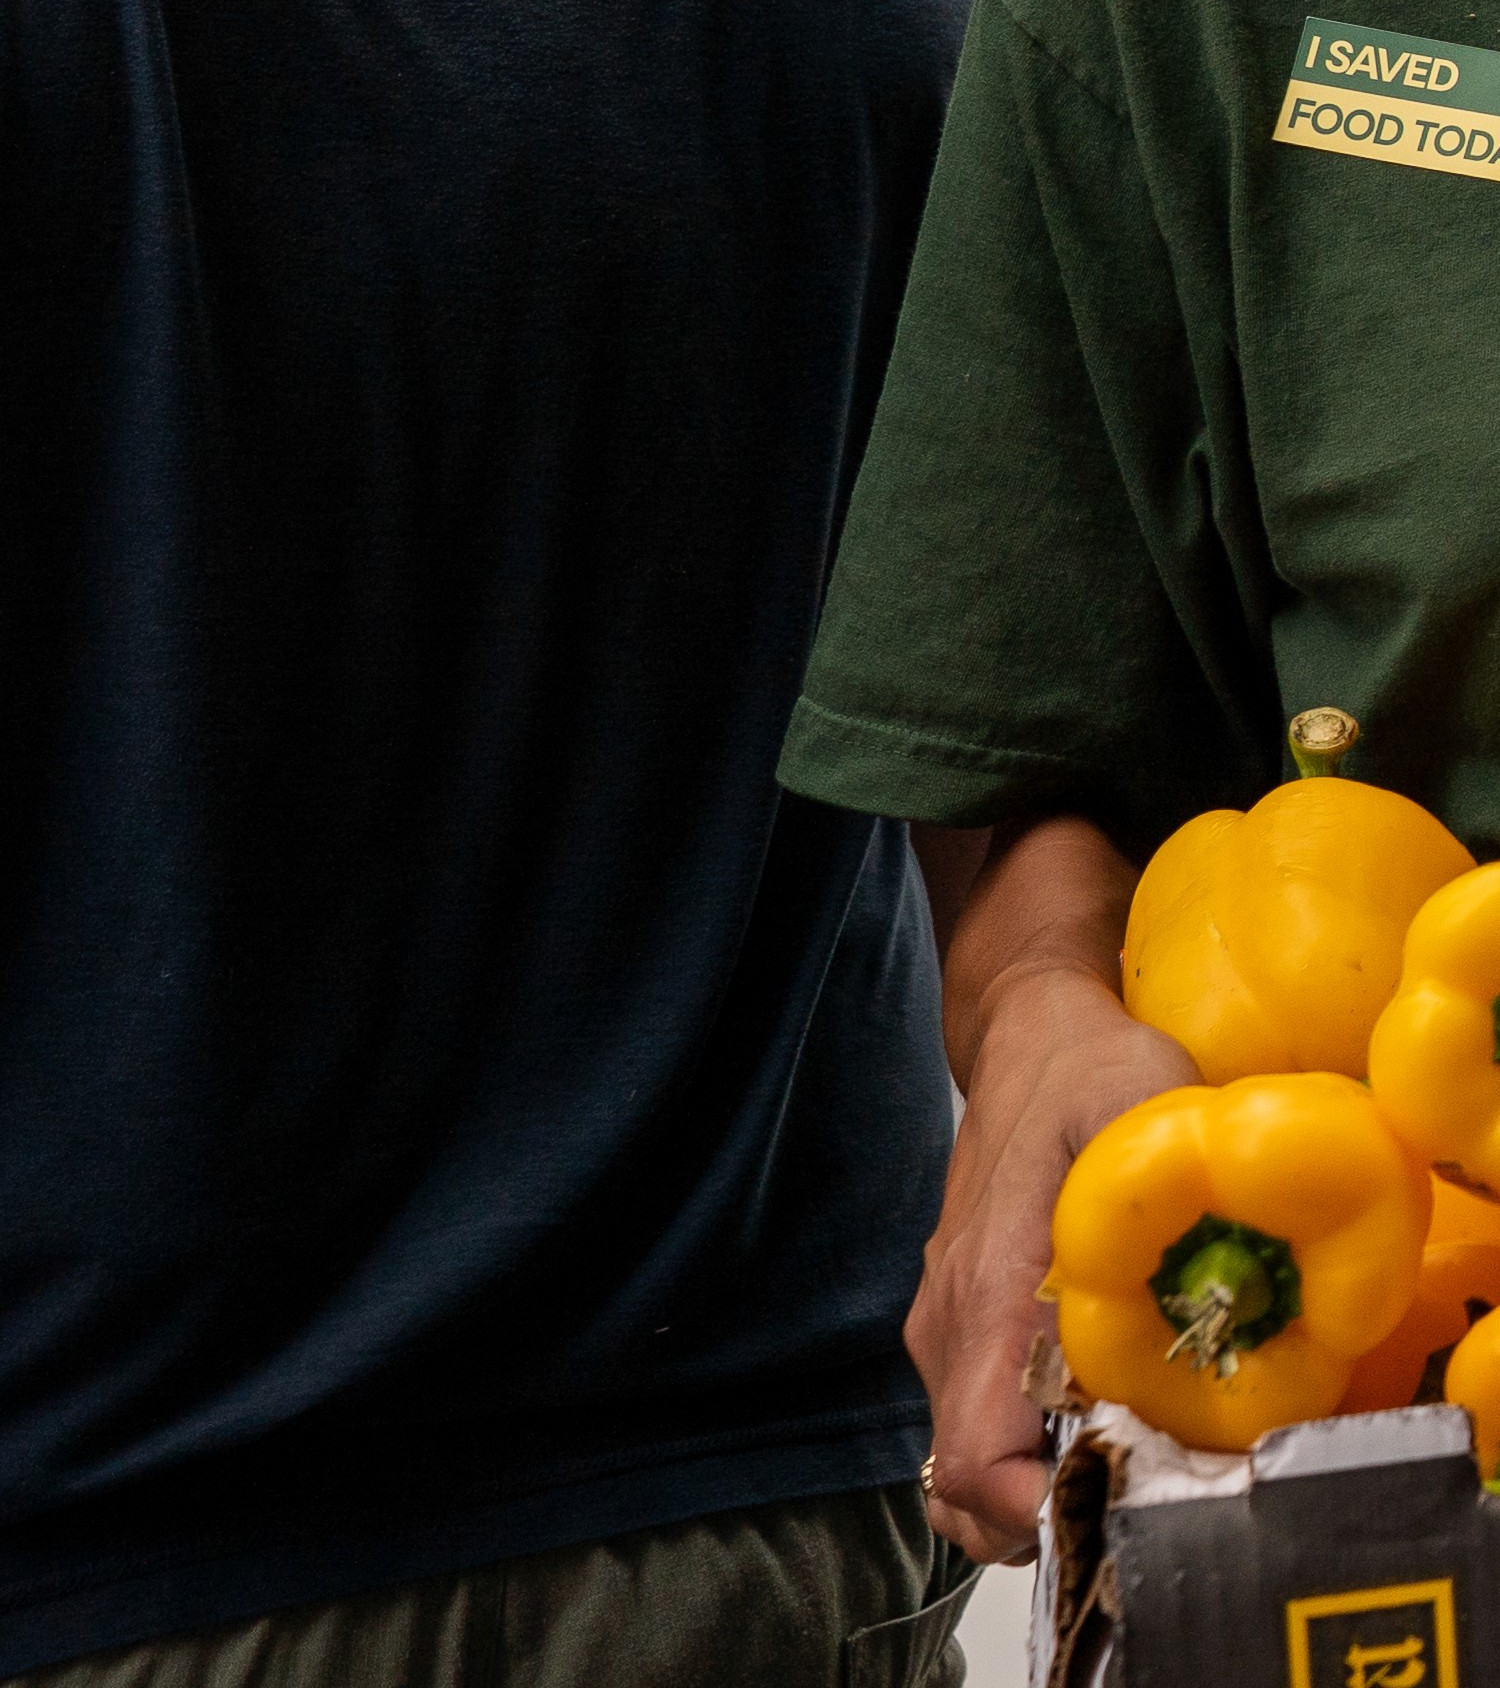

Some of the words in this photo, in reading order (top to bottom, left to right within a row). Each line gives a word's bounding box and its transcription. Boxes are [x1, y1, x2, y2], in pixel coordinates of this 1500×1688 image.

[1305, 35, 1321, 69] I
[1325, 40, 1460, 92] SAVED
[1288, 97, 1404, 146] FOOD
